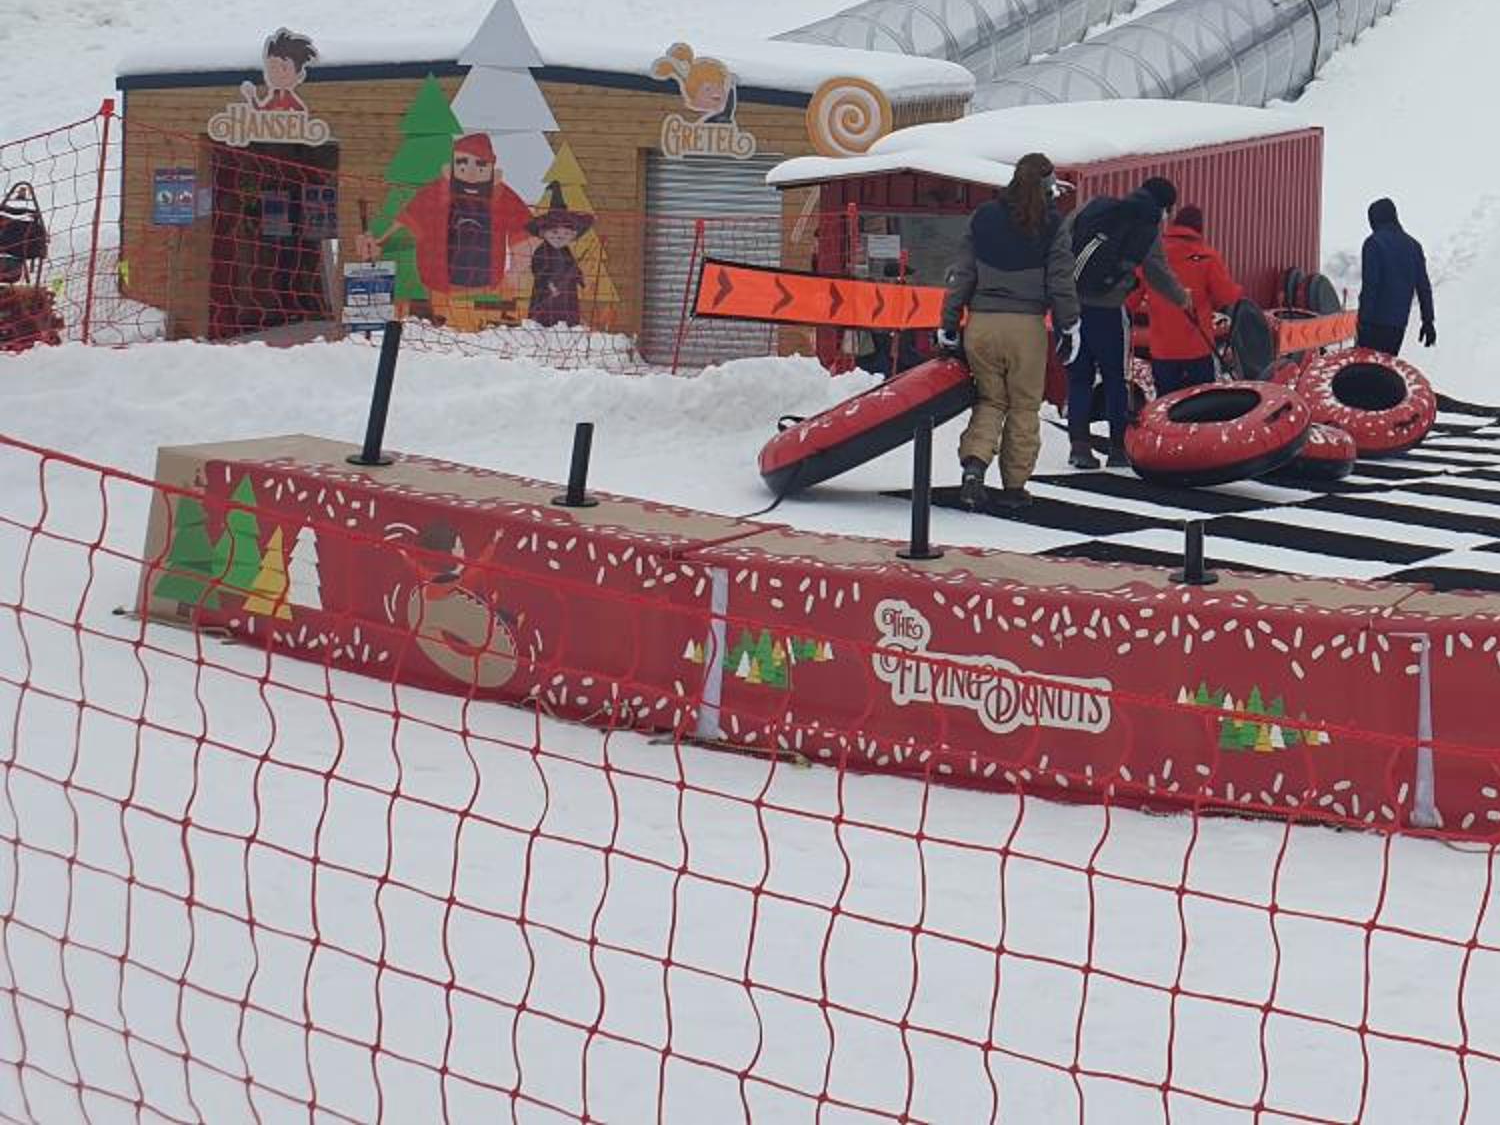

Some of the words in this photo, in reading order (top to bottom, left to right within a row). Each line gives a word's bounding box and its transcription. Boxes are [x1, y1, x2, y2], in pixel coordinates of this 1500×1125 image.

[211, 106, 326, 142] HANSEL
[664, 117, 753, 156] GRETEL
[881, 608, 924, 639] THE
[879, 643, 994, 701] FLYING
[984, 668, 1103, 725] DONUTS
